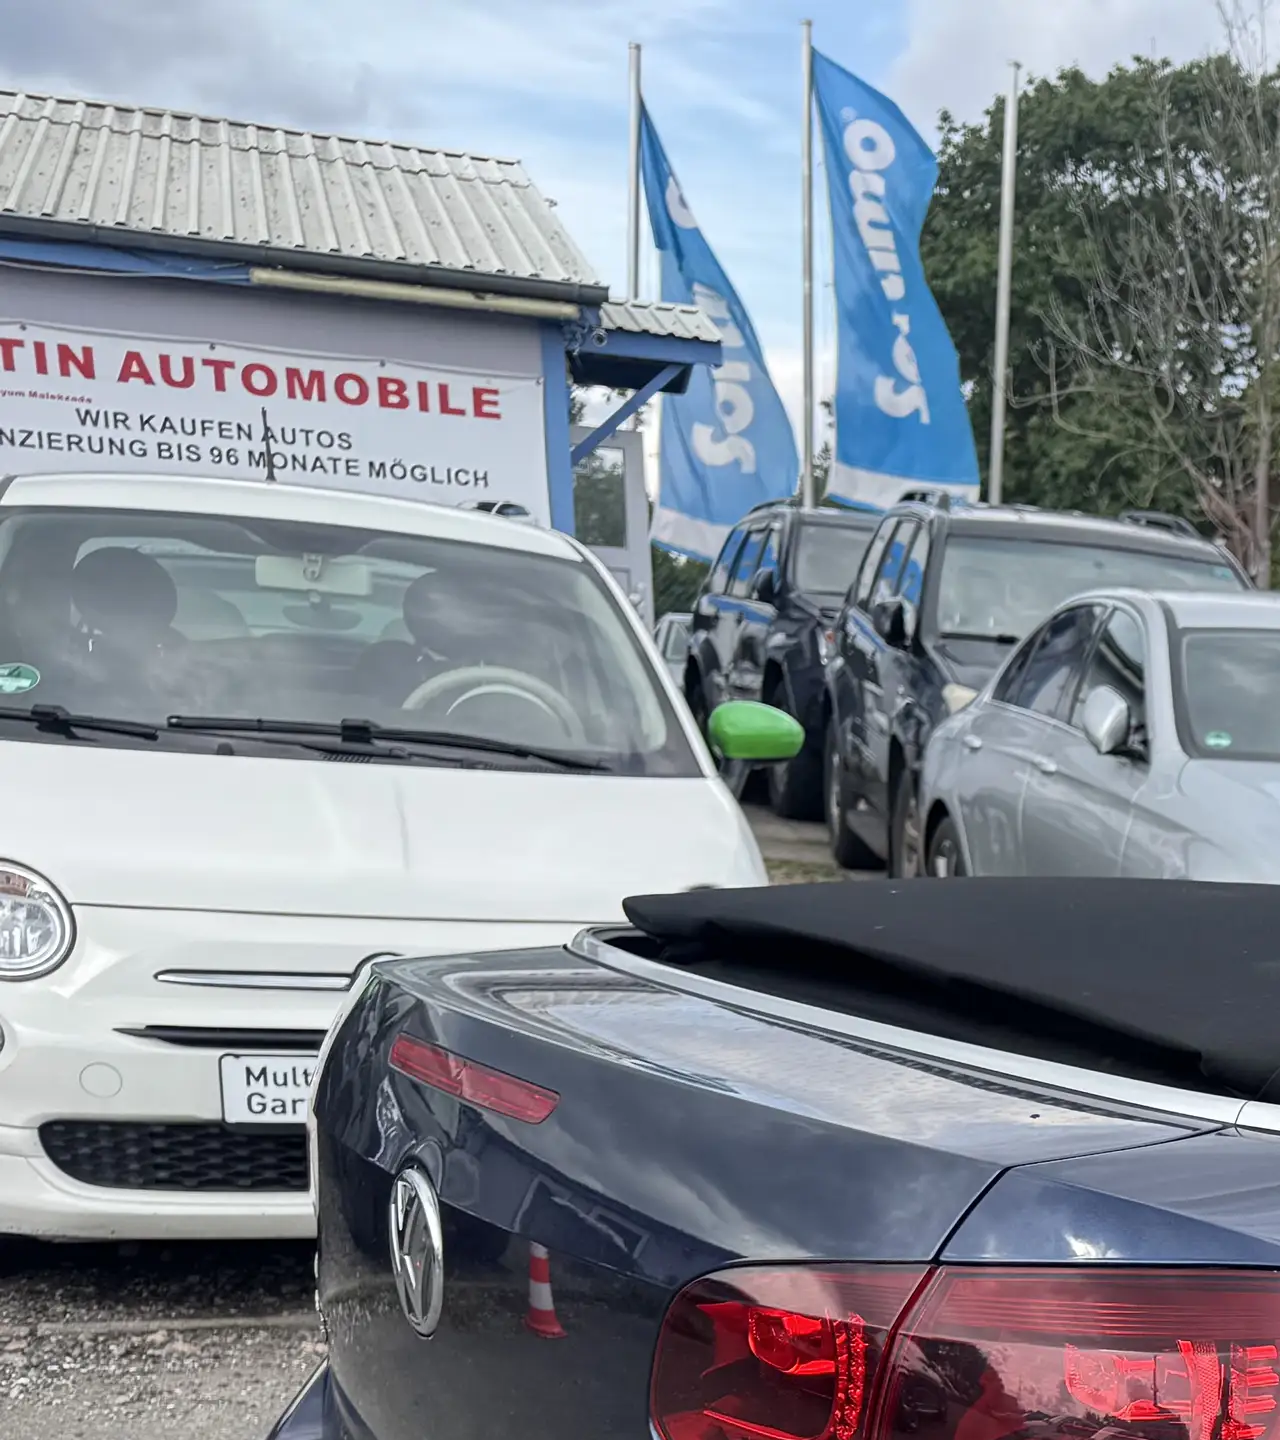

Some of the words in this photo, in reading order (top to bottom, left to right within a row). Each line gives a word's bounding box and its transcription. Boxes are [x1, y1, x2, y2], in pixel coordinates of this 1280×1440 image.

[0, 337, 96, 380] TIN
[117, 351, 501, 420] AUTOMOBILE
[75, 407, 131, 431] WIR
[139, 413, 253, 441] KAUFEN
[261, 426, 353, 450] AUTOS
[0, 427, 148, 458] NZIERUNG
[157, 441, 202, 463] BIS
[209, 446, 239, 466] 96
[248, 450, 361, 477] MONATE
[368, 458, 489, 488] MÖGLICH
[246, 1092, 306, 1115] Gar
